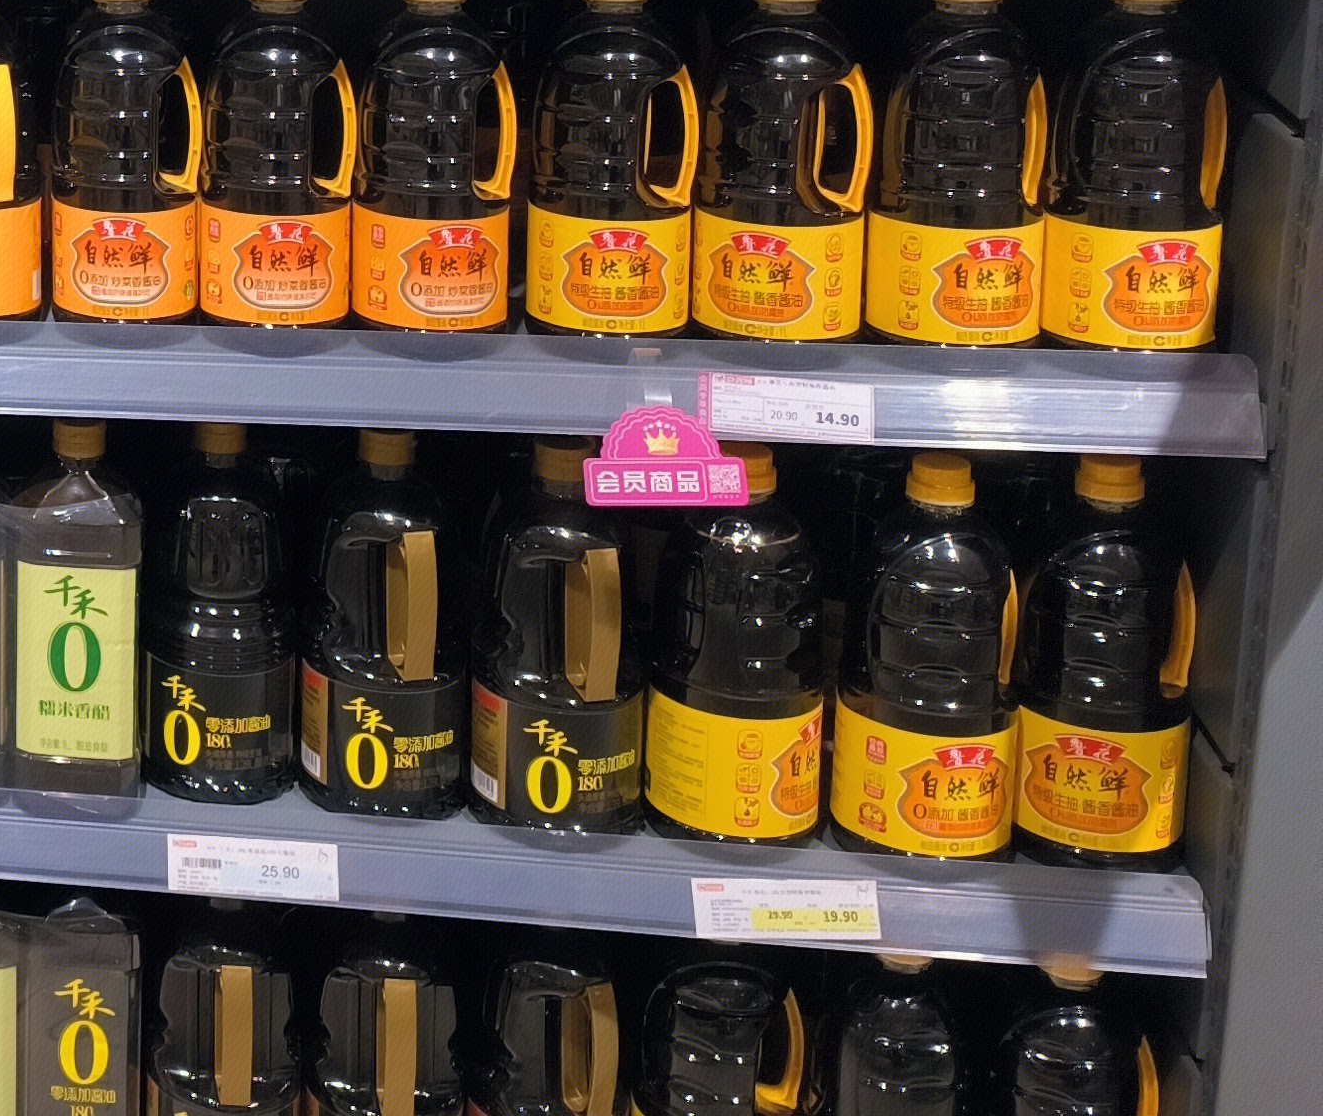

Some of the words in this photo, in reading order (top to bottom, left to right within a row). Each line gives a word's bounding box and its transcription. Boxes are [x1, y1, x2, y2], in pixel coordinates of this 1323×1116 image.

[83, 243, 153, 269] 自然鲜
[249, 244, 318, 272] 自然鲜
[579, 251, 653, 279] 自然鲜
[1125, 264, 1201, 294] 自然鲜
[770, 410, 798, 421] 20.90
[815, 412, 859, 427] 14.90
[596, 470, 700, 494] 会员商品
[523, 719, 578, 756] 千禾
[526, 755, 572, 814] 0
[921, 765, 1001, 802] 自然鲜
[1043, 753, 1128, 800] 自然鲜
[260, 864, 301, 880] 25.90
[822, 910, 860, 924] 19.90
